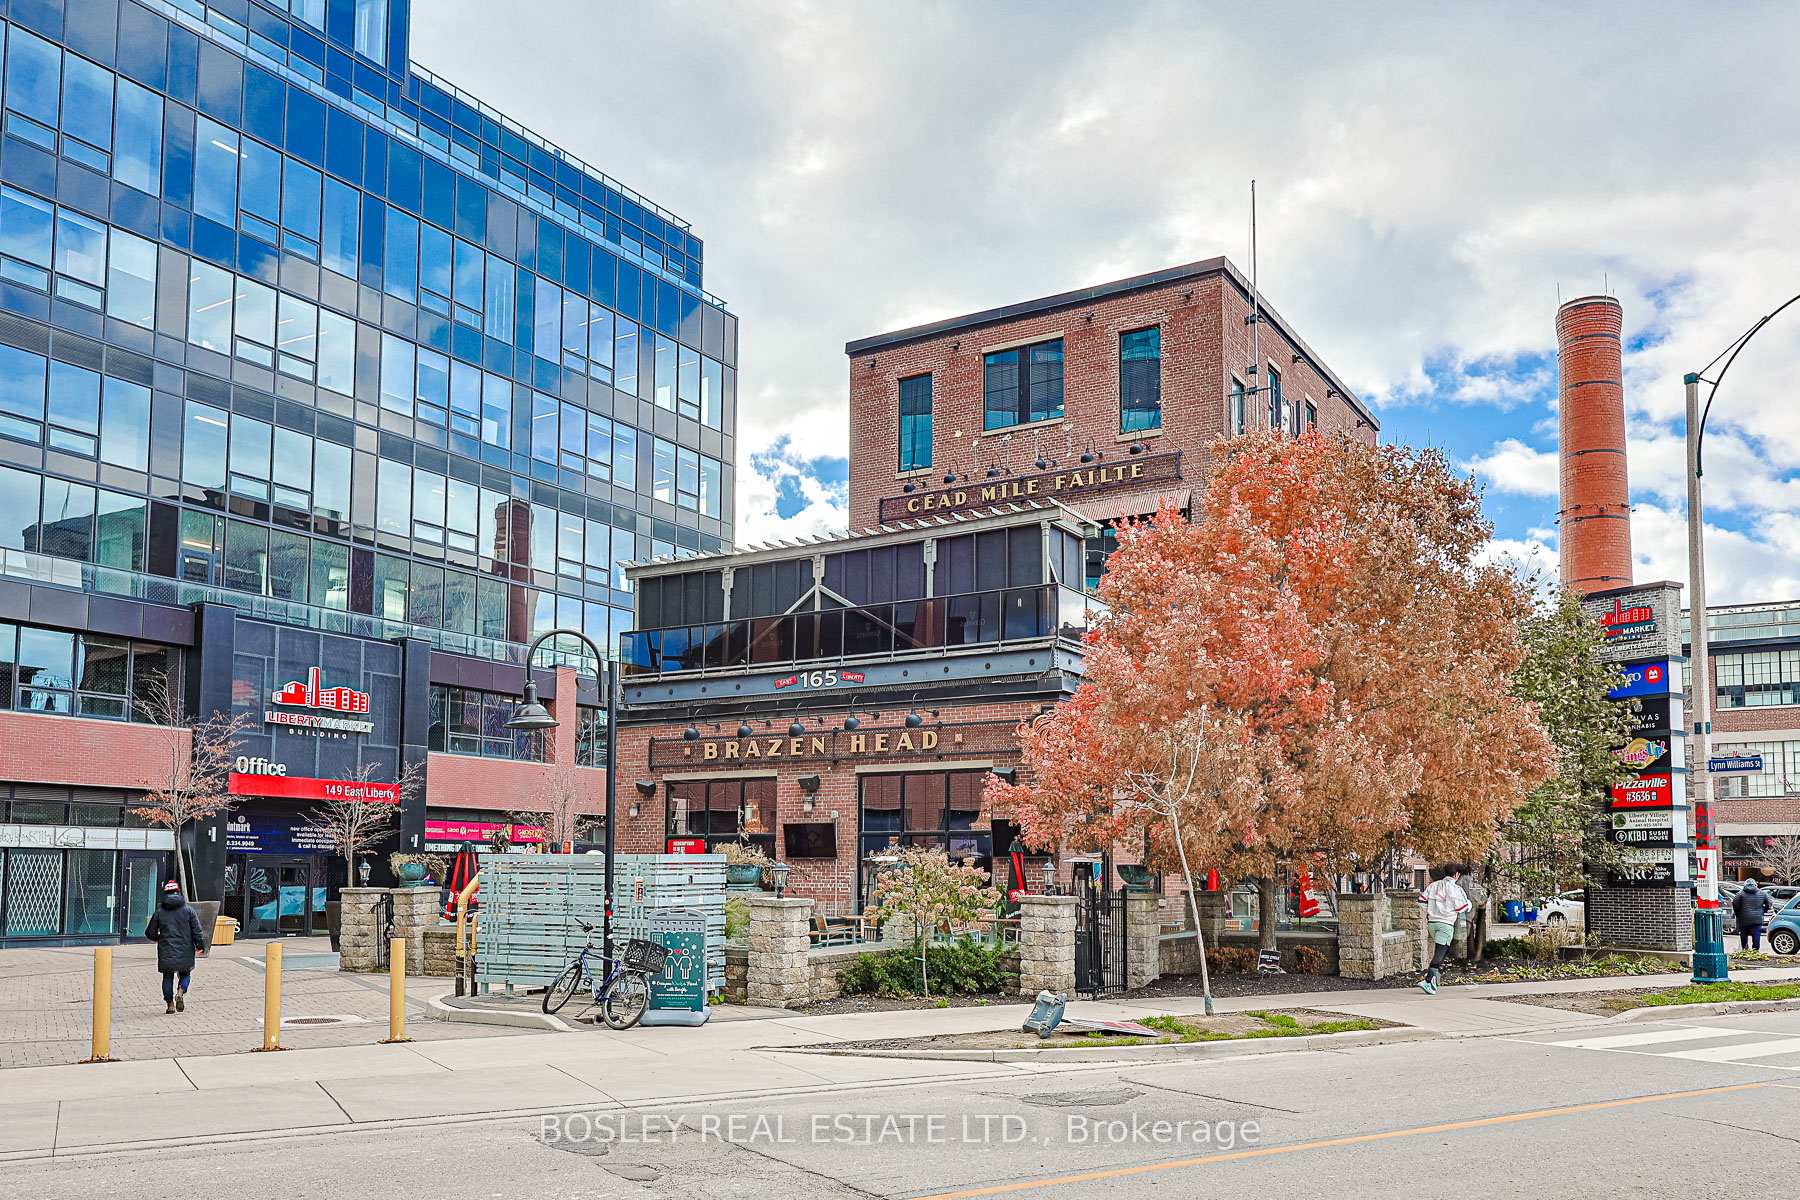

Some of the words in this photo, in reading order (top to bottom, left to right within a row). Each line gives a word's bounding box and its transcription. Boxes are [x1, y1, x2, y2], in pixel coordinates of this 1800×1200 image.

[1622, 625, 1655, 635] MARKET
[800, 669, 838, 688] 165
[289, 728, 348, 740] BUILDING
[704, 737, 827, 761] BRAZEN
[850, 731, 938, 753] HEAD
[236, 756, 287, 777] Office
[1710, 761, 1726, 771] Lynn
[1726, 760, 1754, 769] Williams
[1615, 777, 1668, 790] Pizzaville
[325, 784, 343, 796] 149
[344, 785, 364, 797] East
[365, 787, 395, 801] Liberty
[1626, 790, 1650, 802] #3636
[1628, 830, 1647, 841] KIBO
